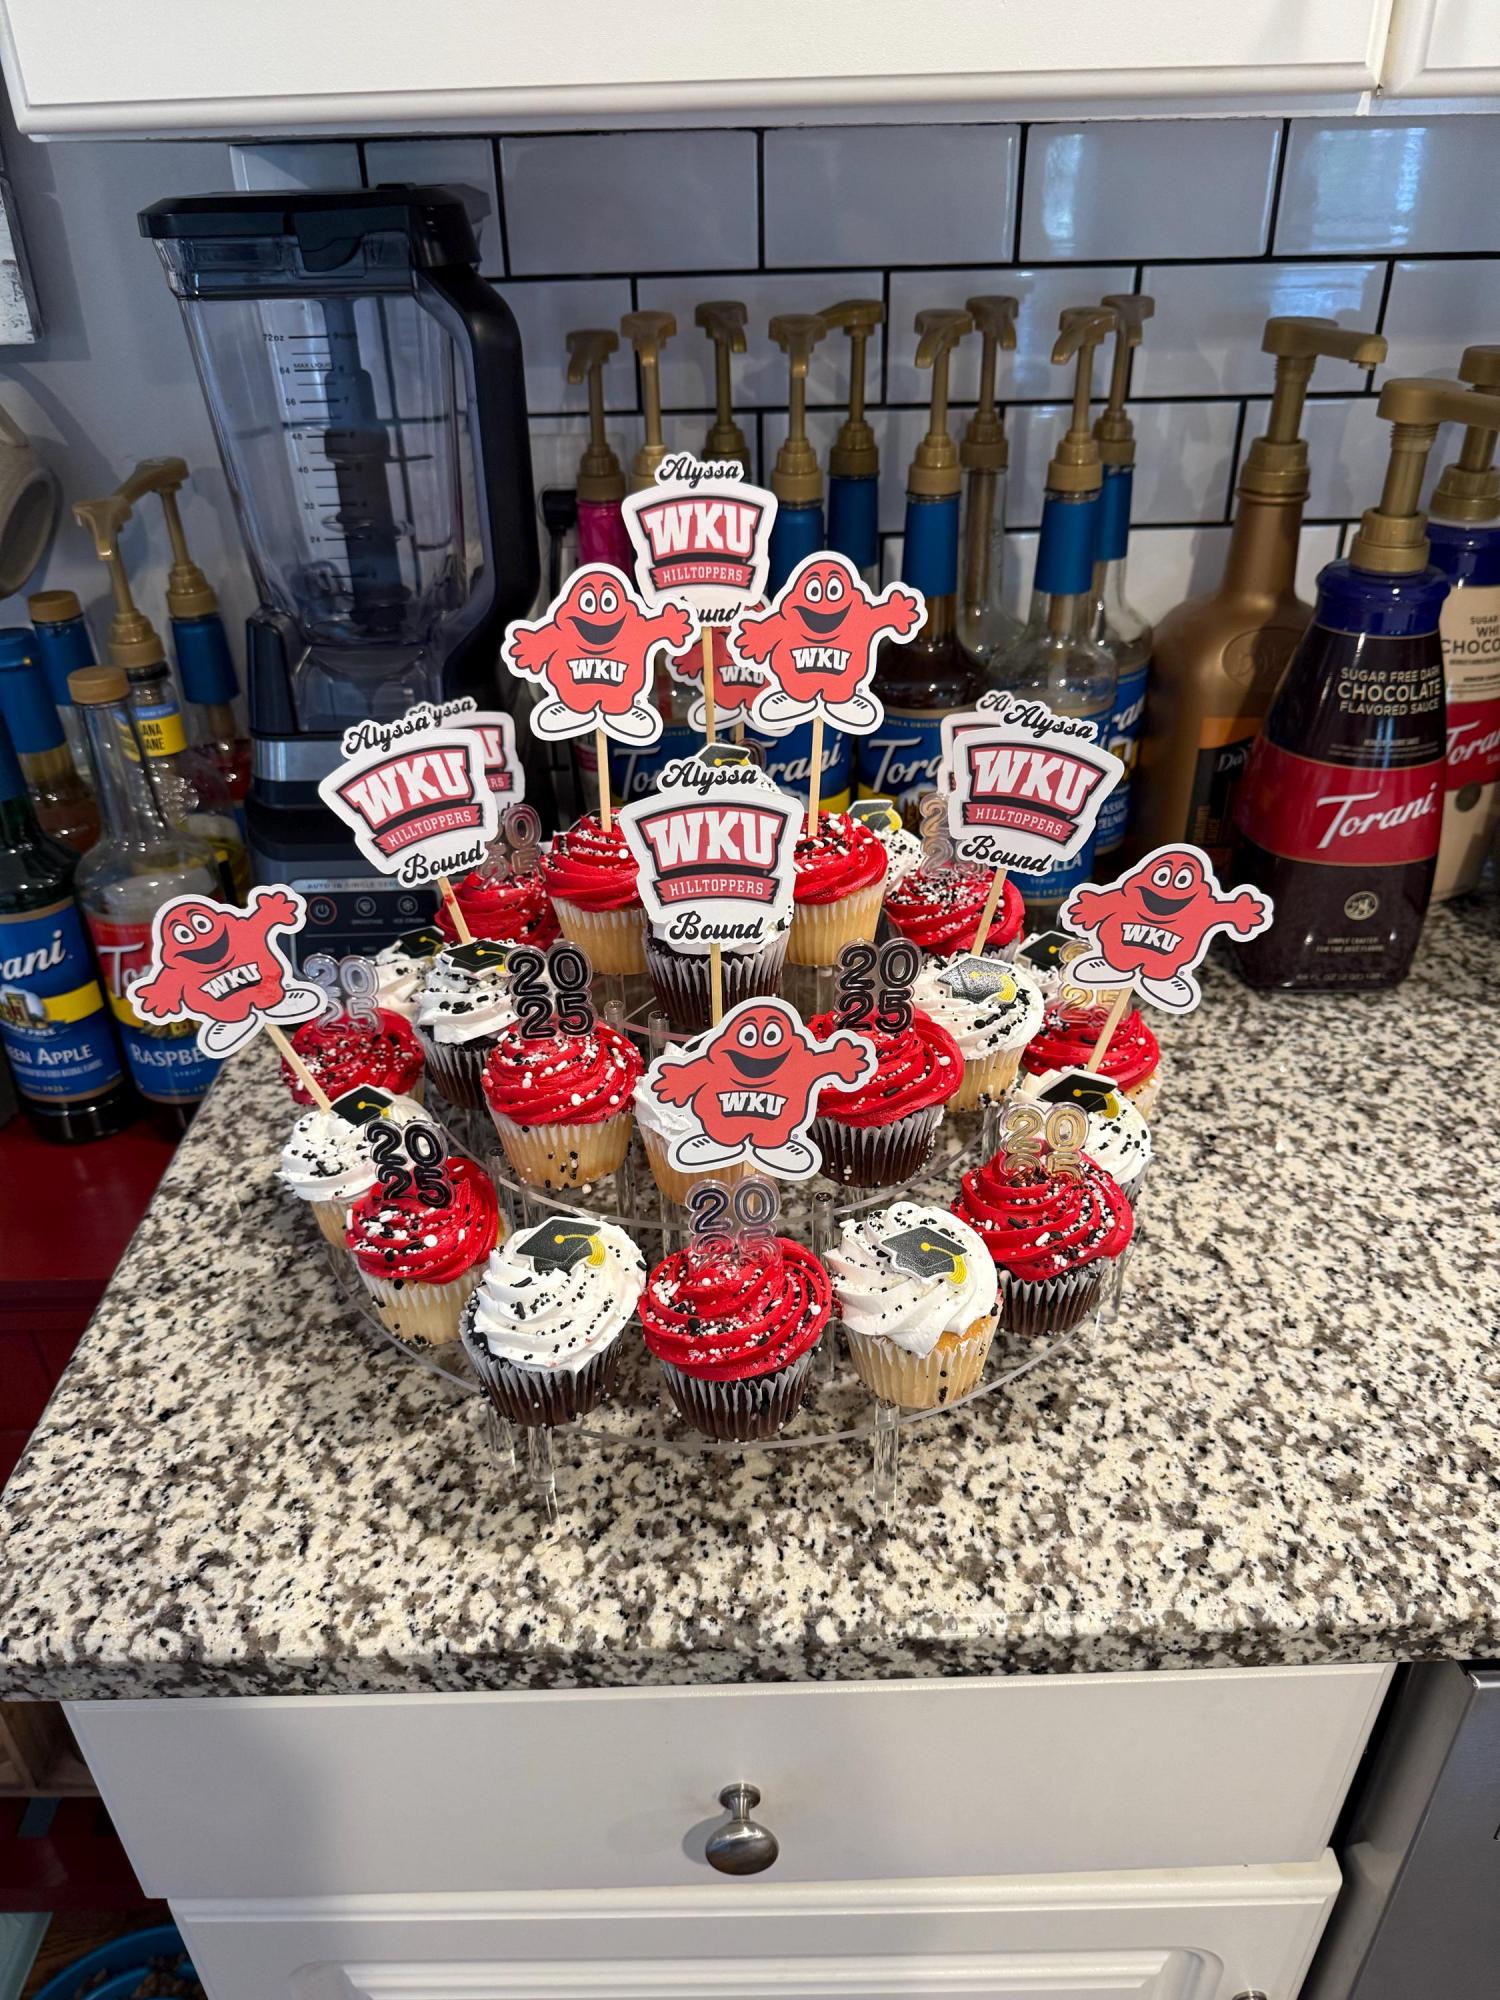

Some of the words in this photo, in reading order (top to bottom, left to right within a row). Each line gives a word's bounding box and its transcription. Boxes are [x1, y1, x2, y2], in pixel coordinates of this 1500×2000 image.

[659, 457, 740, 489] Alyssa
[644, 503, 757, 556] WKU
[662, 567, 744, 583] HILLTOPPERS
[694, 601, 742, 623] und
[1440, 638, 1500, 656] CHOCO
[1476, 625, 1500, 637] WHI
[568, 658, 628, 684] WKU
[792, 648, 851, 671] WKU
[1341, 667, 1386, 682] SUGAR
[1390, 670, 1418, 682] FREE
[1338, 678, 1442, 702] CHOCOLATE
[1340, 701, 1408, 716] FLAVORED
[1410, 698, 1439, 714] SAUCE
[346, 715, 430, 754] Alyssa
[1003, 705, 1095, 738] Alyssa
[661, 761, 758, 796] Alyssa
[868, 736, 945, 795] Tora
[975, 750, 1100, 811] WKU
[345, 752, 467, 825] WKU
[387, 810, 472, 847] HILLTOPPERS
[976, 807, 1063, 836] HILLTOPPERS
[1316, 782, 1438, 849] Torani
[644, 810, 780, 867] WKU
[962, 835, 1052, 872] Bound
[402, 840, 484, 884] Bound
[669, 879, 764, 897] HILLTOPPERS
[669, 910, 764, 940] Bound
[1122, 923, 1183, 952] WKU
[200, 963, 262, 999] WKU
[506, 947, 591, 997] 20
[837, 940, 920, 991] 20
[515, 992, 595, 1040] 25
[837, 989, 916, 1034] 25
[37, 1044, 93, 1066] APPLE
[130, 1043, 206, 1068] RASPBE
[718, 1092, 788, 1116] WKU
[366, 1119, 448, 1169] 20
[1002, 1103, 1089, 1151] 20
[374, 1164, 452, 1208] 25
[688, 1178, 780, 1234] 20
